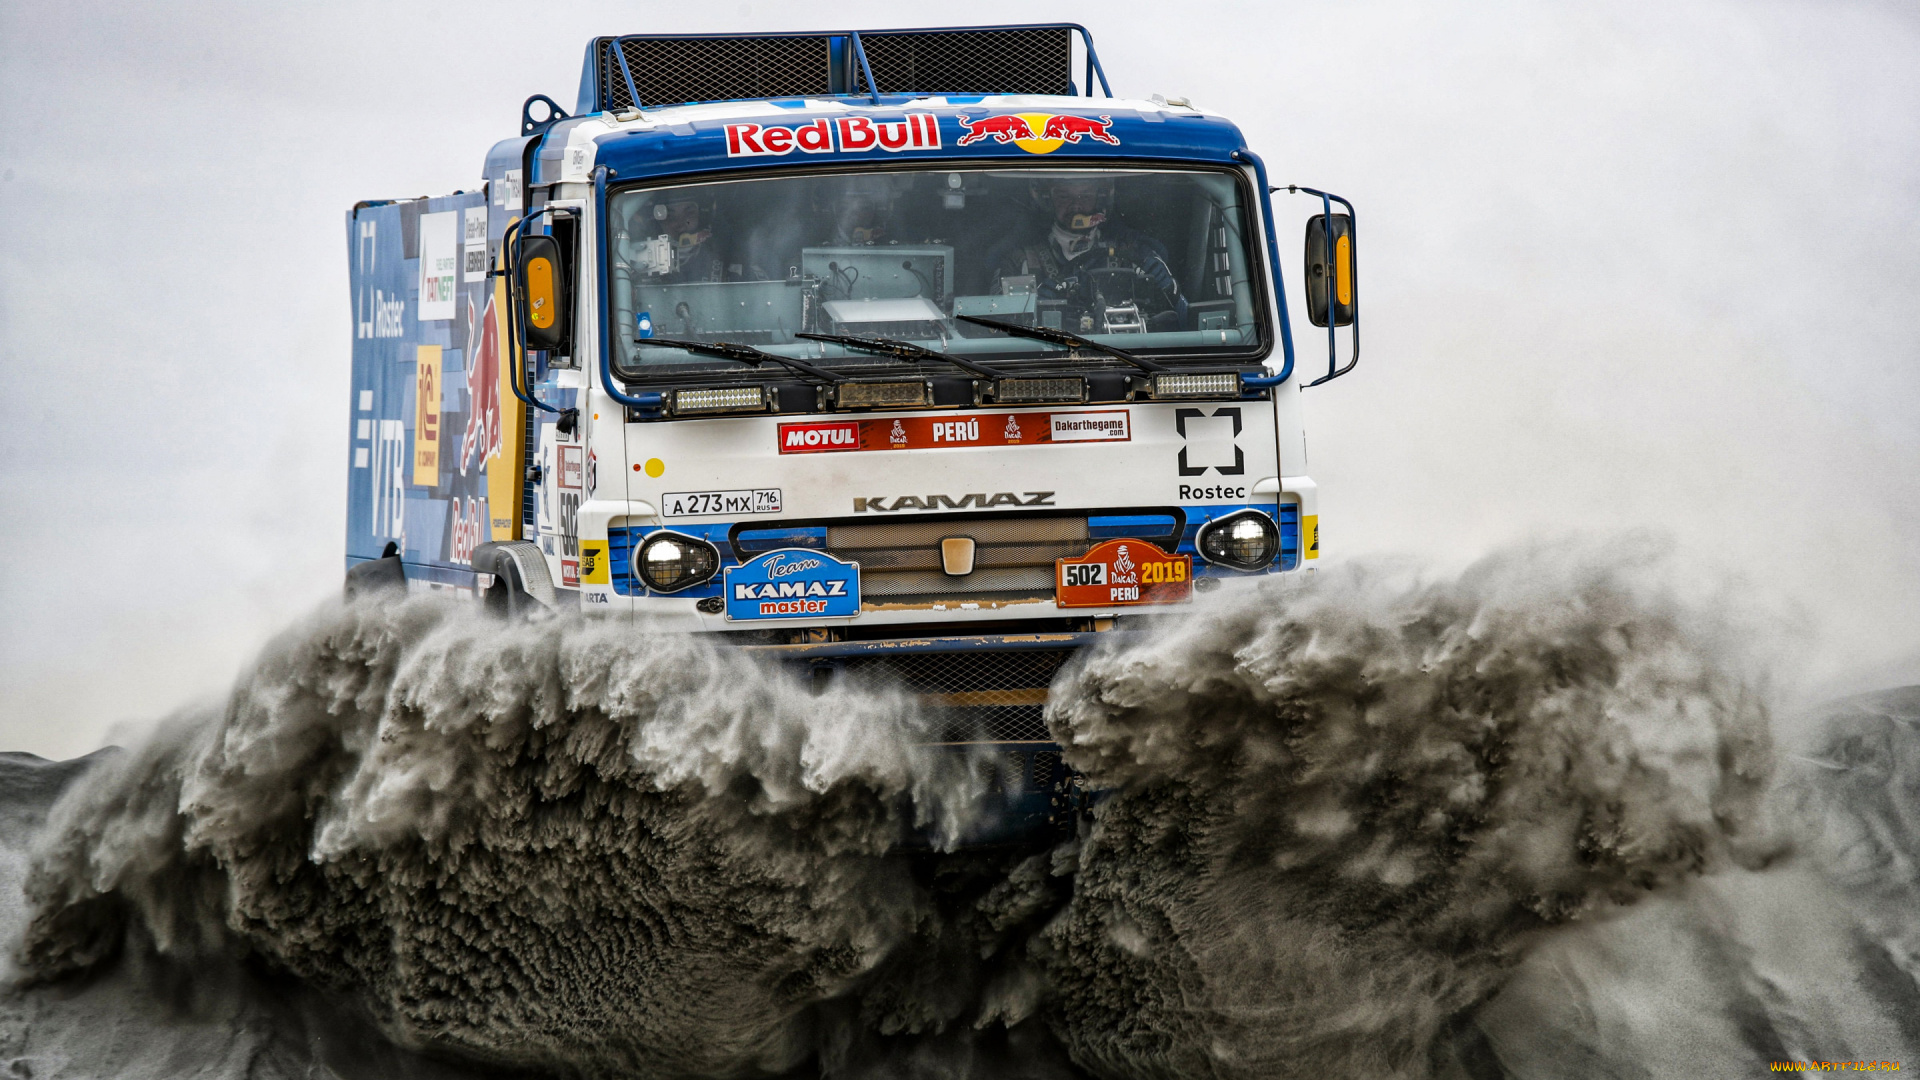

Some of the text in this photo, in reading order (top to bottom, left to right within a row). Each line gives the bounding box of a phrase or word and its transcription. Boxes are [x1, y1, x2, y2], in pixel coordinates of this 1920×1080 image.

[724, 113, 941, 157] Red Bull
[426, 275, 454, 303] TATNEFT
[375, 289, 405, 338] Rostec
[932, 417, 980, 443] PERÚ
[1055, 419, 1124, 432] Dakarthegame
[1107, 429, 1124, 437] .com
[785, 428, 855, 447] MOTUL
[371, 419, 405, 539] VTB
[756, 491, 777, 504] 716
[853, 490, 1056, 513] KAMAZ
[1178, 484, 1246, 500] Rostec
[450, 495, 470, 565] Red
[560, 491, 580, 557] 502
[763, 554, 820, 580] Team
[1066, 564, 1103, 587] 502
[1111, 572, 1138, 585] DAKAR
[1140, 561, 1186, 584] 2019
[734, 580, 848, 601] KAMAZ
[1110, 586, 1140, 602] PERÚ
[759, 599, 828, 615] master
